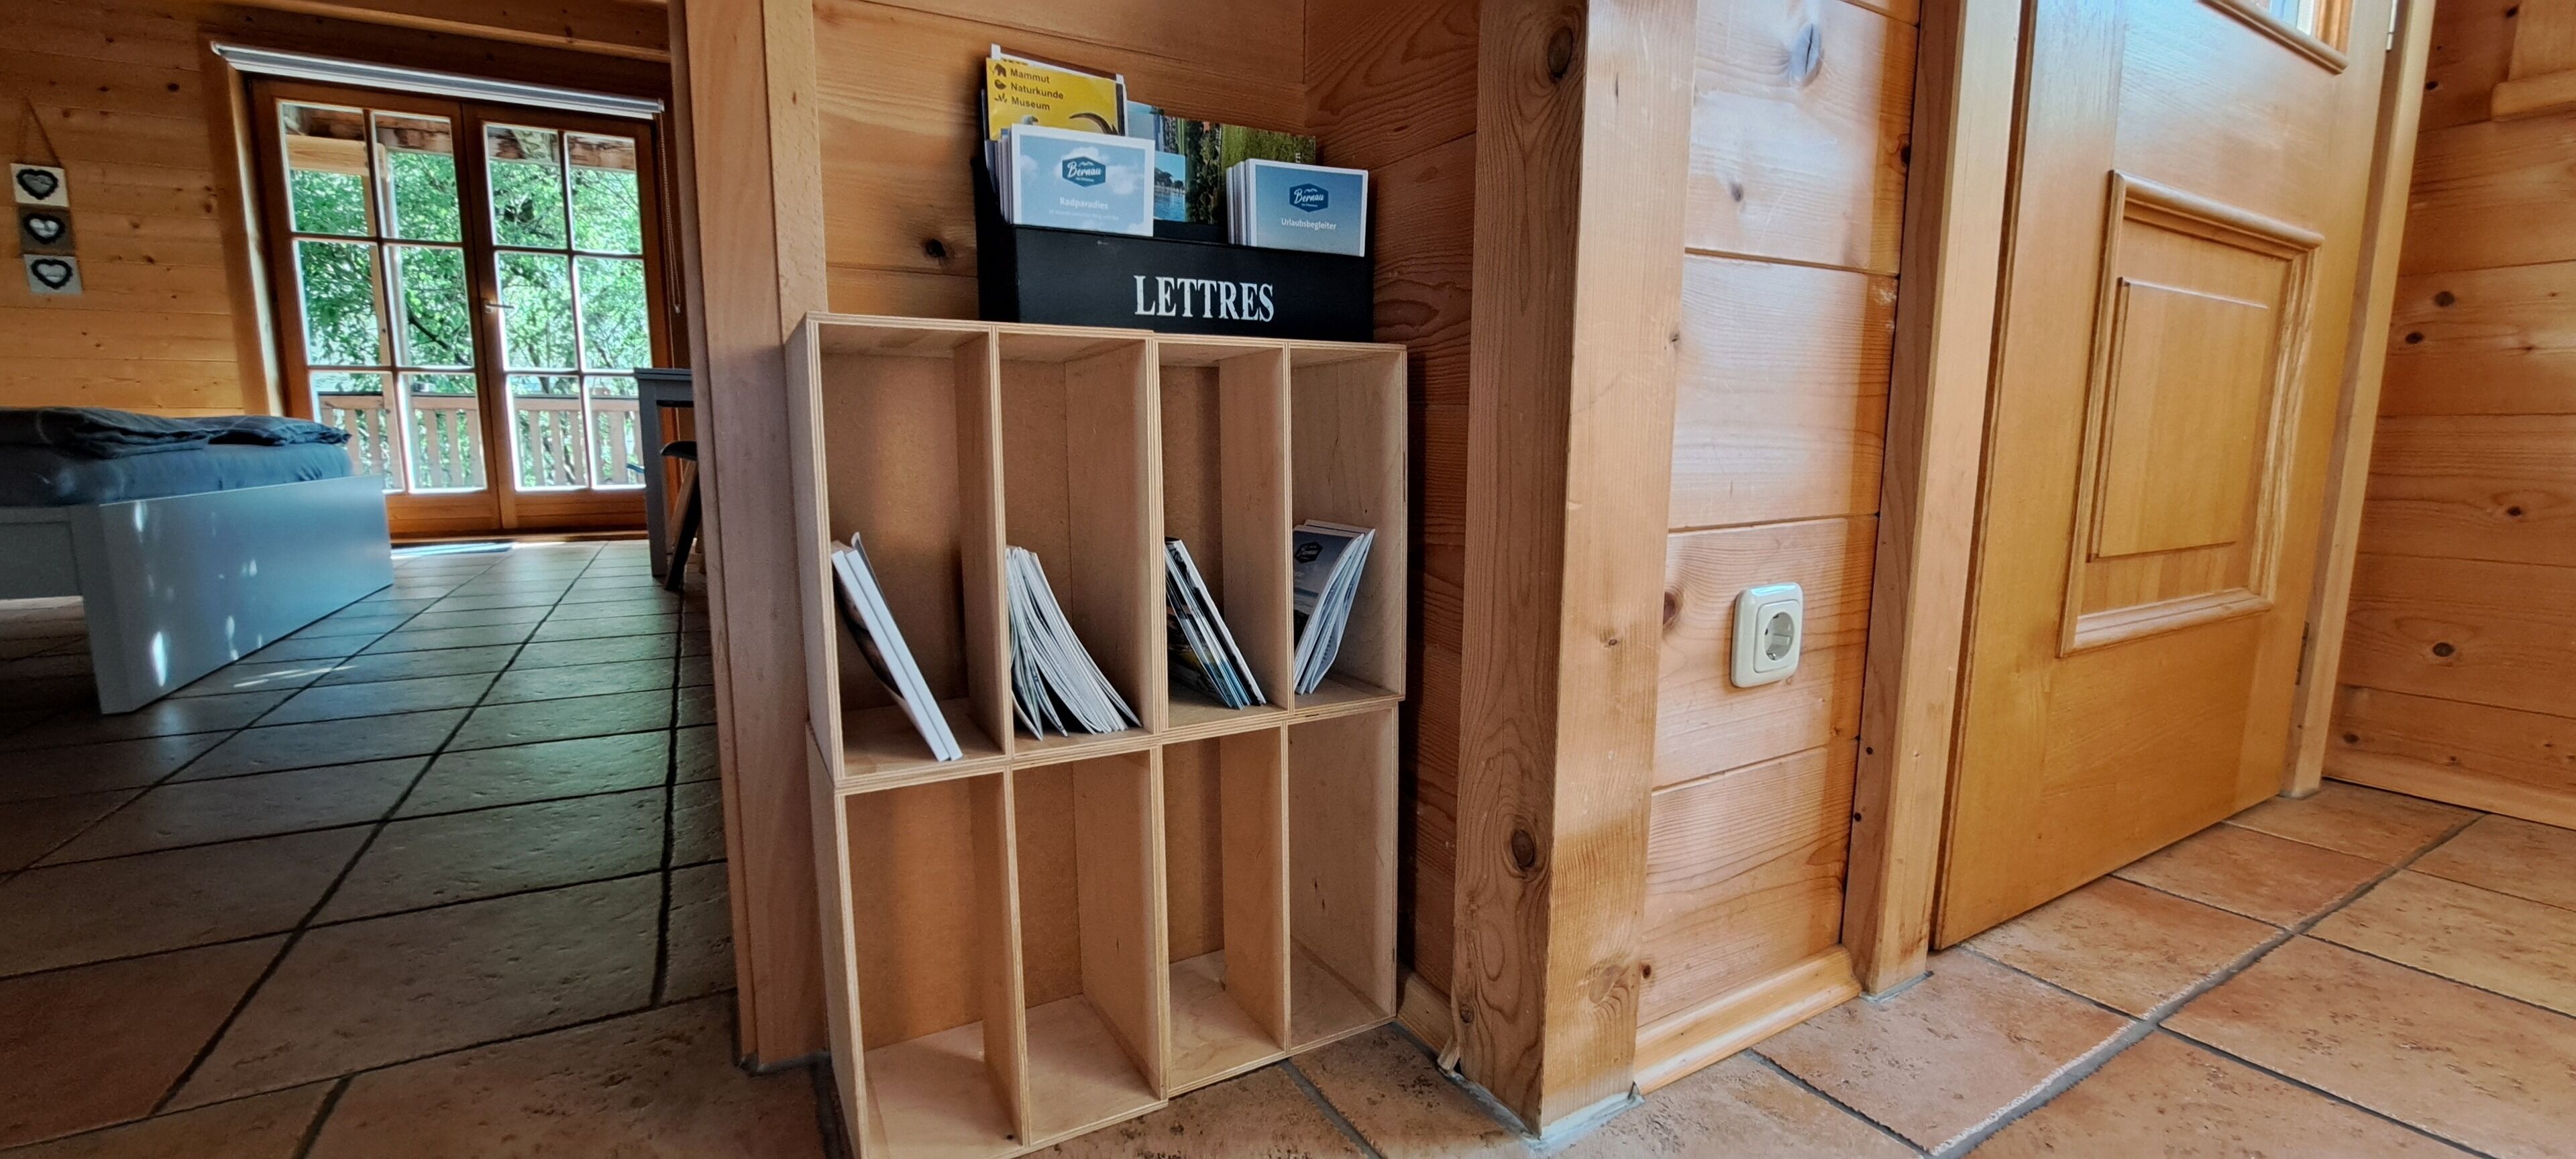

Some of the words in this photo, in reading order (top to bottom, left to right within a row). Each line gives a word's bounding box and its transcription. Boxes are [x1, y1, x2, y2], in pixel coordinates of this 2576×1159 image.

[1010, 68, 1050, 84] Mammut
[1010, 82, 1064, 99] Naturkunde
[1011, 96, 1051, 111] Museum
[1067, 161, 1102, 178] Bernau
[1059, 197, 1109, 210] Radparadies
[1293, 188, 1324, 205] Bernau
[1281, 218, 1337, 231] Urlaubsbegleiter
[1132, 275, 1275, 323] LETTRES
